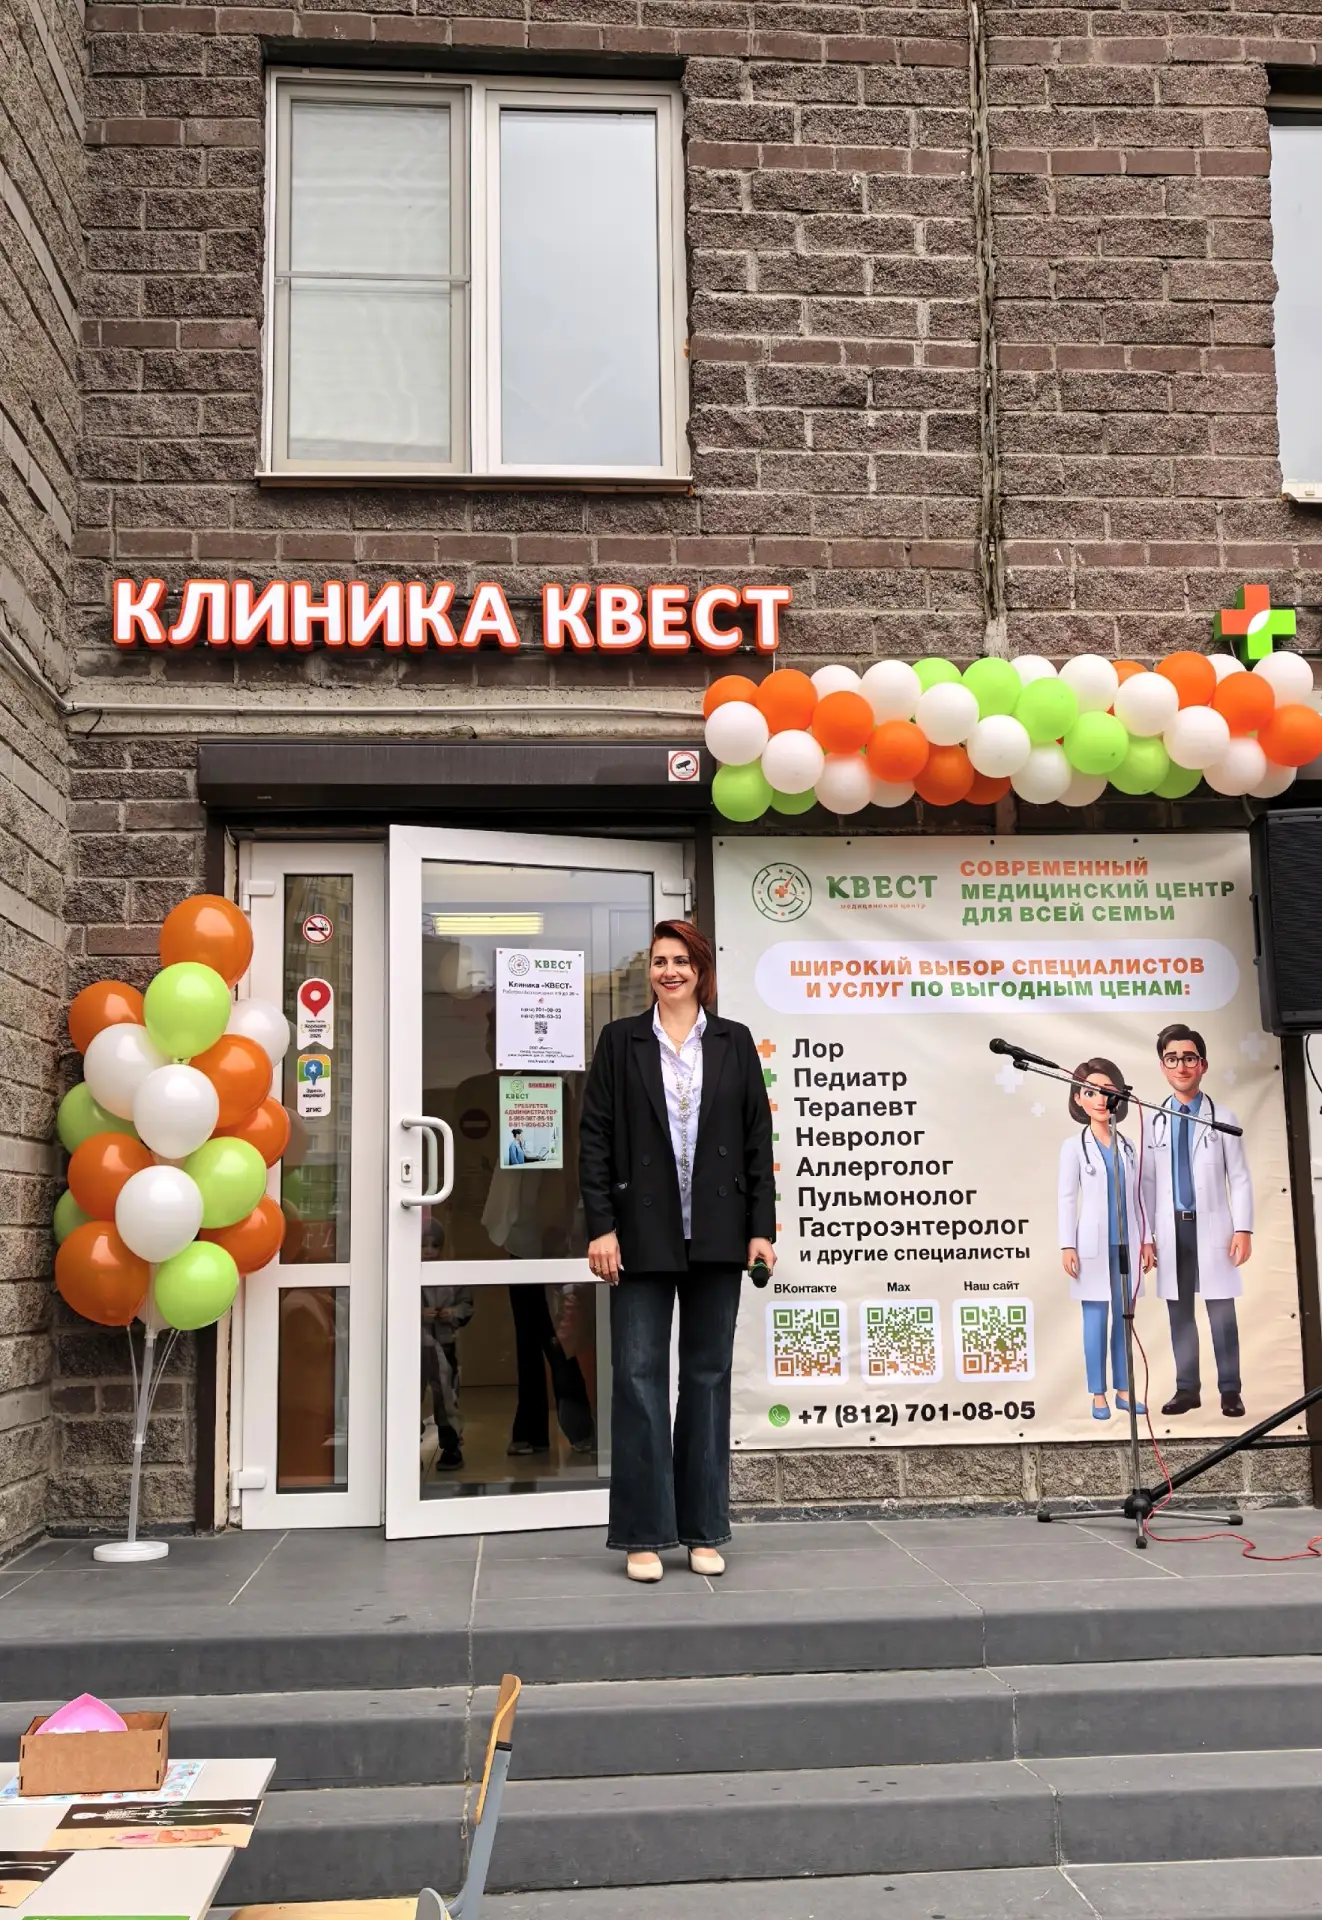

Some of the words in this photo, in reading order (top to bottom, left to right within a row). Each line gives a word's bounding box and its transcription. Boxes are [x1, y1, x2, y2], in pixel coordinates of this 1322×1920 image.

[112, 579, 521, 652] КЛИНИКА
[543, 583, 794, 653] КВЕСТ
[960, 857, 1149, 877] СОВРЕМЕННЫЙ
[826, 875, 938, 899] КВЕСТ
[961, 879, 1149, 902] МЕДИЦИНСКИЙ
[1155, 881, 1235, 901] ЦЕНТР
[962, 906, 1013, 926] ДЛЯ
[1020, 902, 1085, 922] ВСЕЙ
[1092, 905, 1175, 921] СЕМЬИ
[534, 960, 572, 970] КВЕСТ
[790, 957, 912, 977] ШИРОКИЙ
[919, 960, 1005, 976] ВЫБОР
[1012, 958, 1205, 978] СПЕЦИАЛИСТОВ
[508, 981, 540, 989] Клиника
[806, 982, 820, 998] И
[828, 982, 904, 999] УСЛУГ
[911, 981, 944, 997] ПО
[950, 980, 1093, 1000] ВЫГОДНЫМ
[1100, 980, 1191, 999] ЦЕНАМ:
[792, 1038, 844, 1062] Лор
[794, 1067, 907, 1091] Педиатр
[794, 1097, 917, 1121] Терапевт
[796, 1127, 925, 1151] Невролог
[796, 1156, 953, 1180] Аллерголог
[798, 1187, 977, 1211] Пульмонолог
[799, 1217, 1029, 1241] Гастроэнтеролог
[800, 1249, 811, 1262] и
[817, 1247, 889, 1265] другие
[894, 1246, 1030, 1263] специалисты
[774, 1283, 837, 1294] ВКонтакте
[964, 1280, 990, 1291] Наш
[993, 1280, 1020, 1291] сайт
[798, 1405, 828, 1424] +7
[835, 1404, 899, 1428] (812)
[905, 1401, 1037, 1423] 701-08-05
